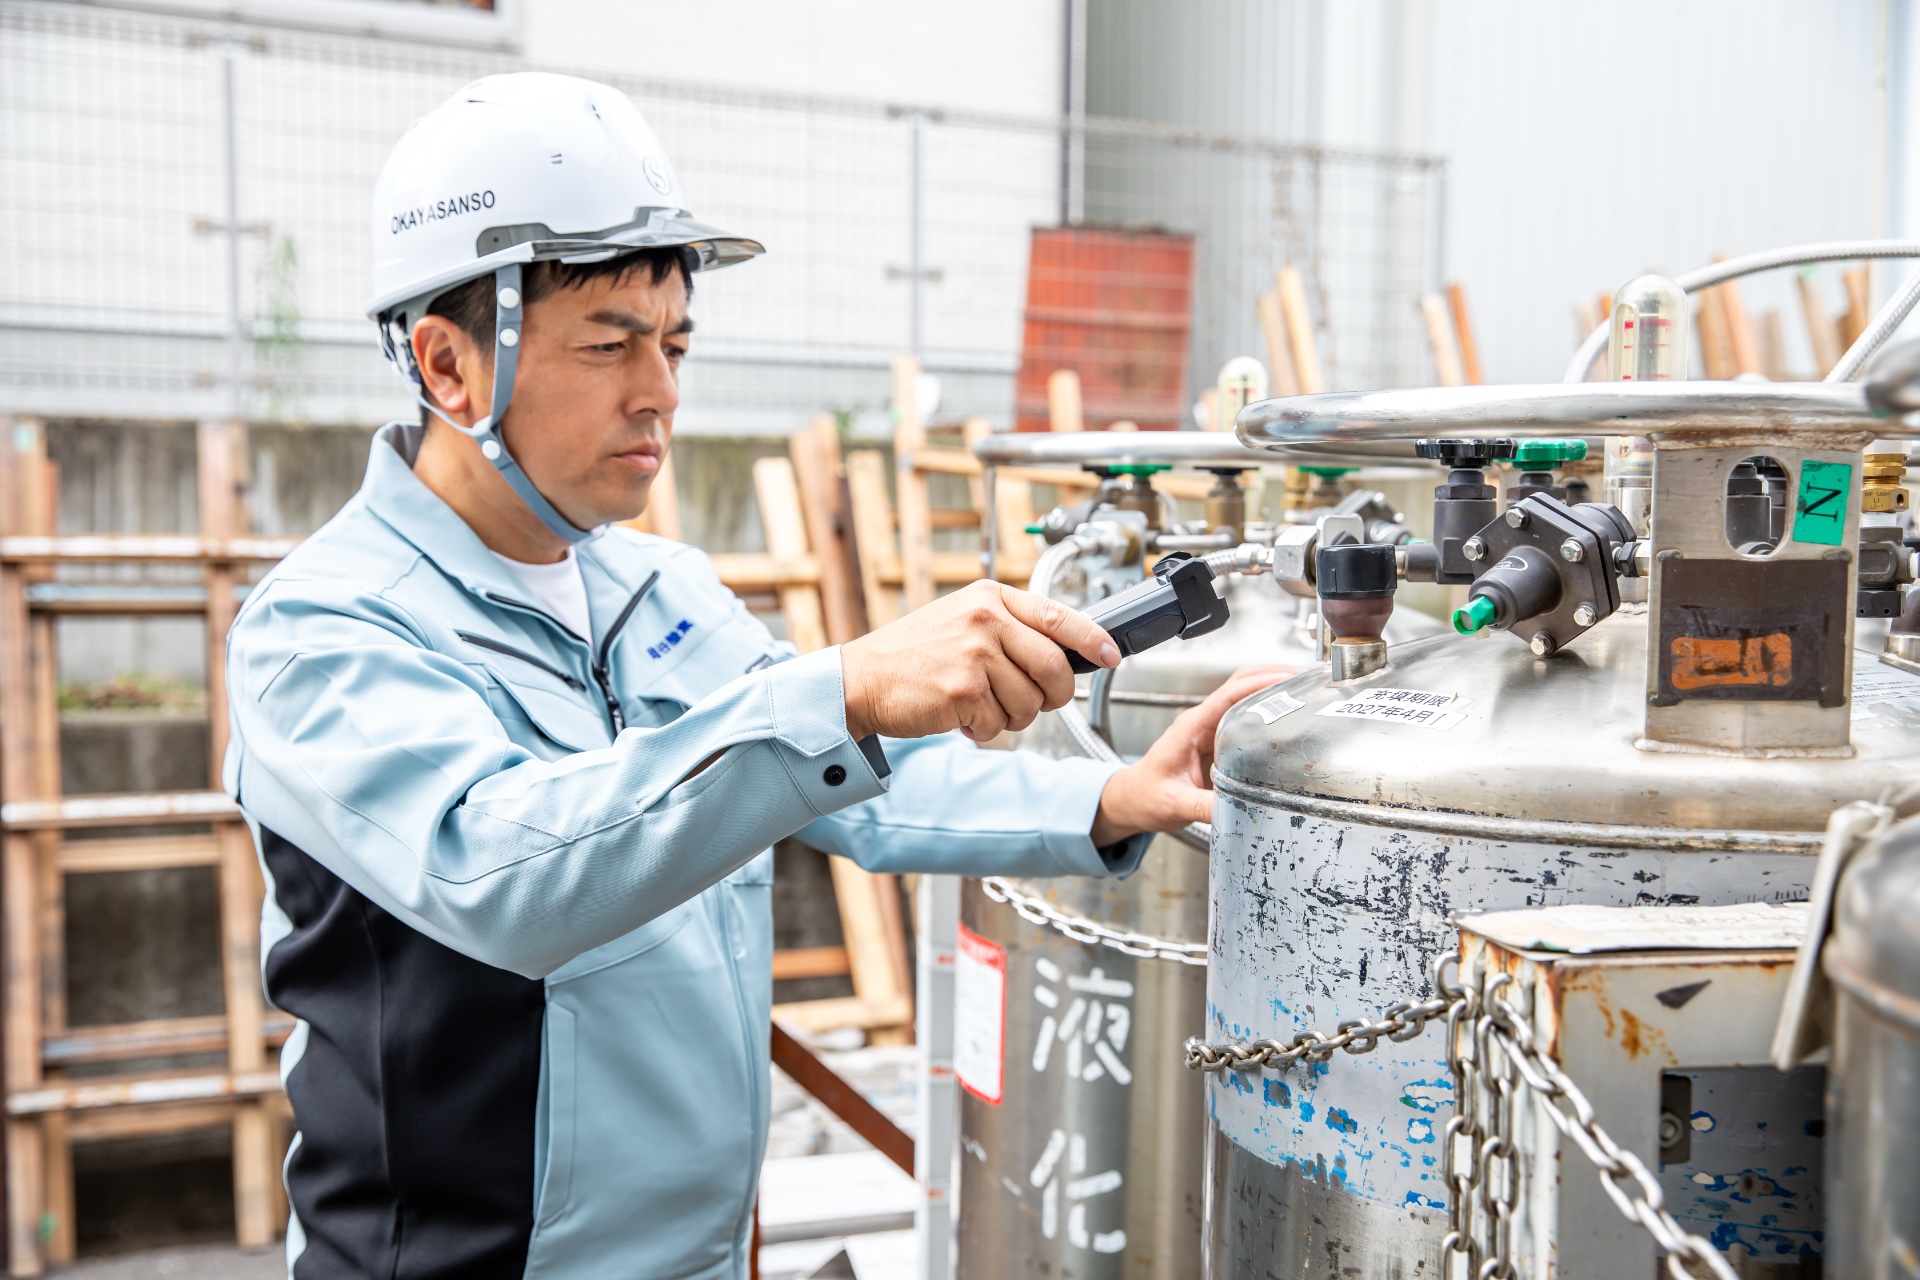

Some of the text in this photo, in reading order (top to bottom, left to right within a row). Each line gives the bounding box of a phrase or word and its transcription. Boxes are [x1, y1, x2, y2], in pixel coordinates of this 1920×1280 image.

[391, 190, 495, 234] OKAYASANSO
[1803, 481, 1842, 523] N
[1366, 690, 1451, 707] 充填期限
